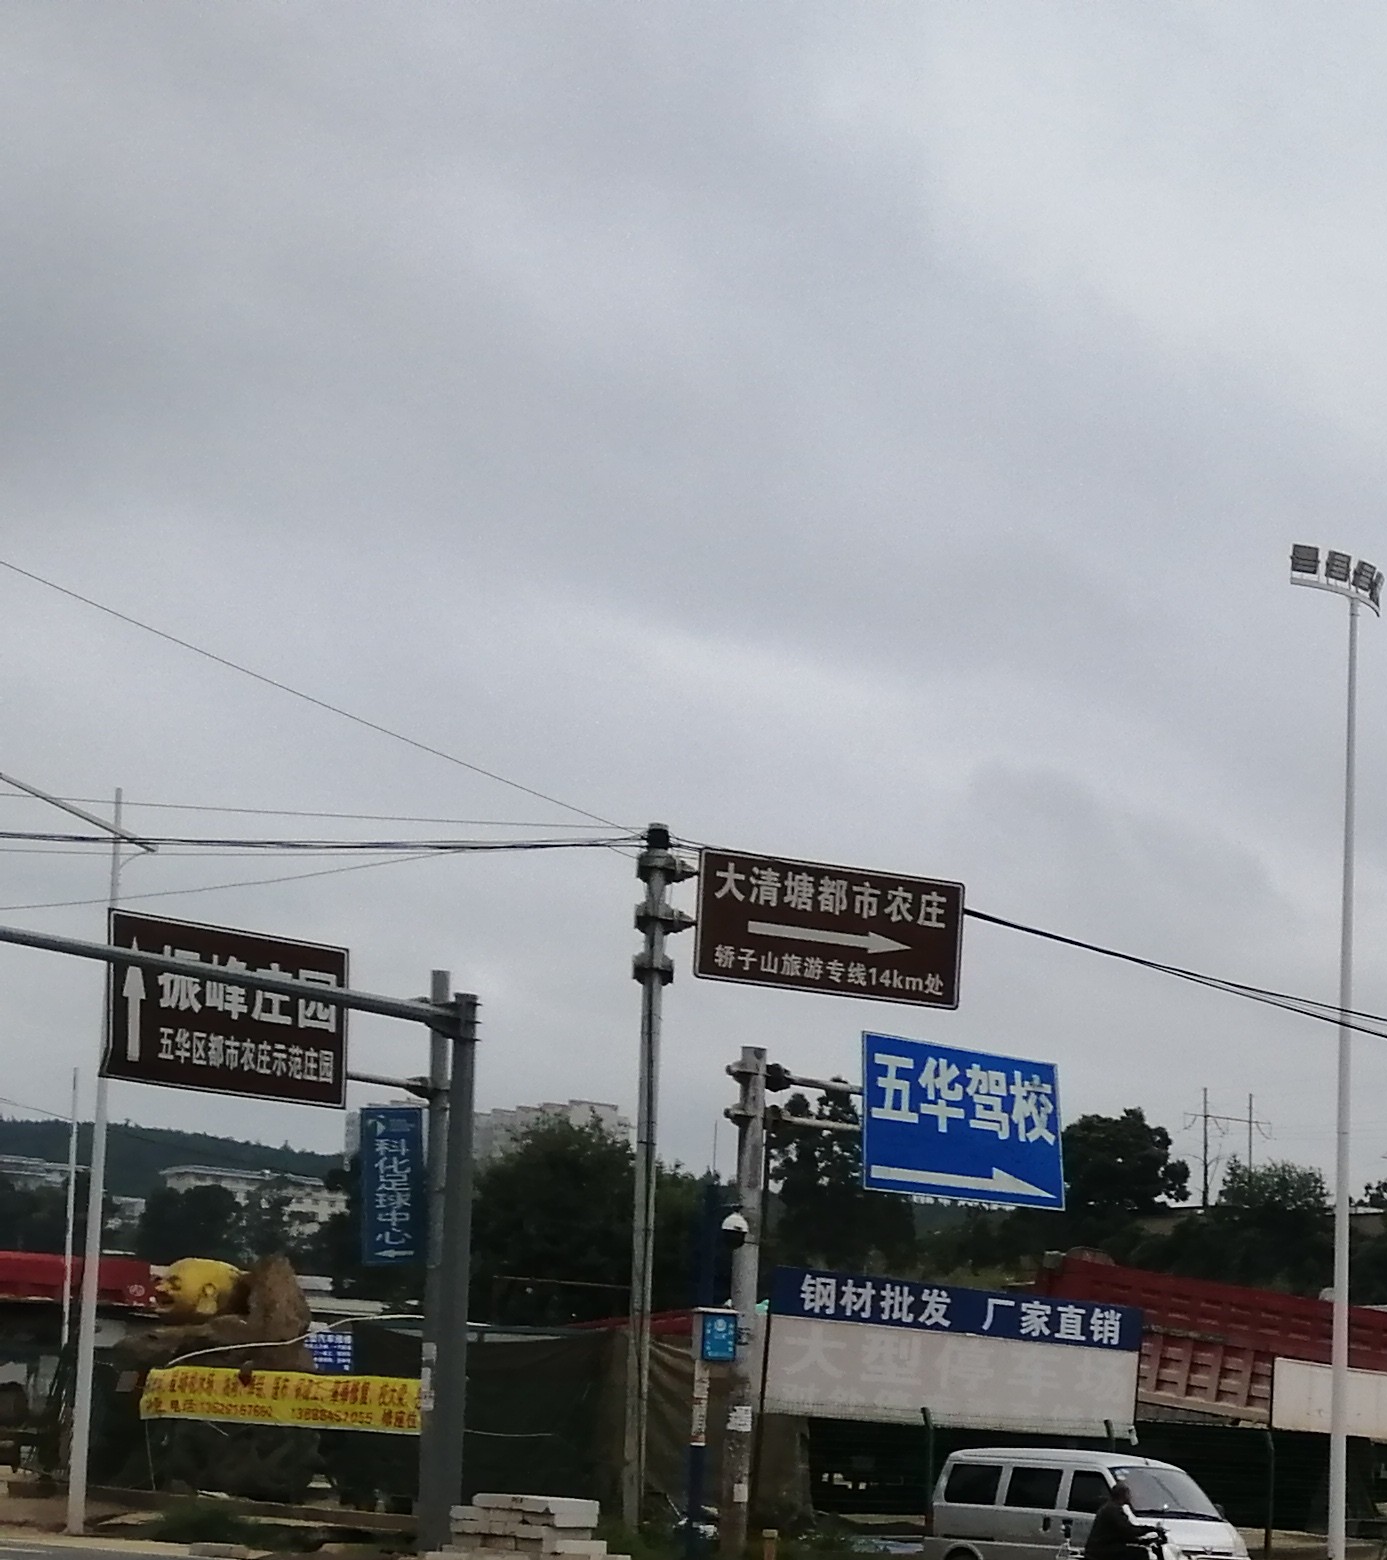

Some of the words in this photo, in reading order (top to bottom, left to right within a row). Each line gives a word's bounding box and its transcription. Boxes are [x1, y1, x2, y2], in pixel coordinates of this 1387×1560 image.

[714, 862, 948, 929] 大清塘都市农庄
[157, 945, 337, 1033] 振峰庄园
[714, 944, 944, 996] 轿子山旅游专线14km处
[158, 1027, 334, 1084] 五华区都市农庄示范庄园
[871, 1053, 1056, 1146] 五华驾校
[801, 1273, 951, 1328] 钢材批发
[982, 1297, 1122, 1345] 厂家直销
